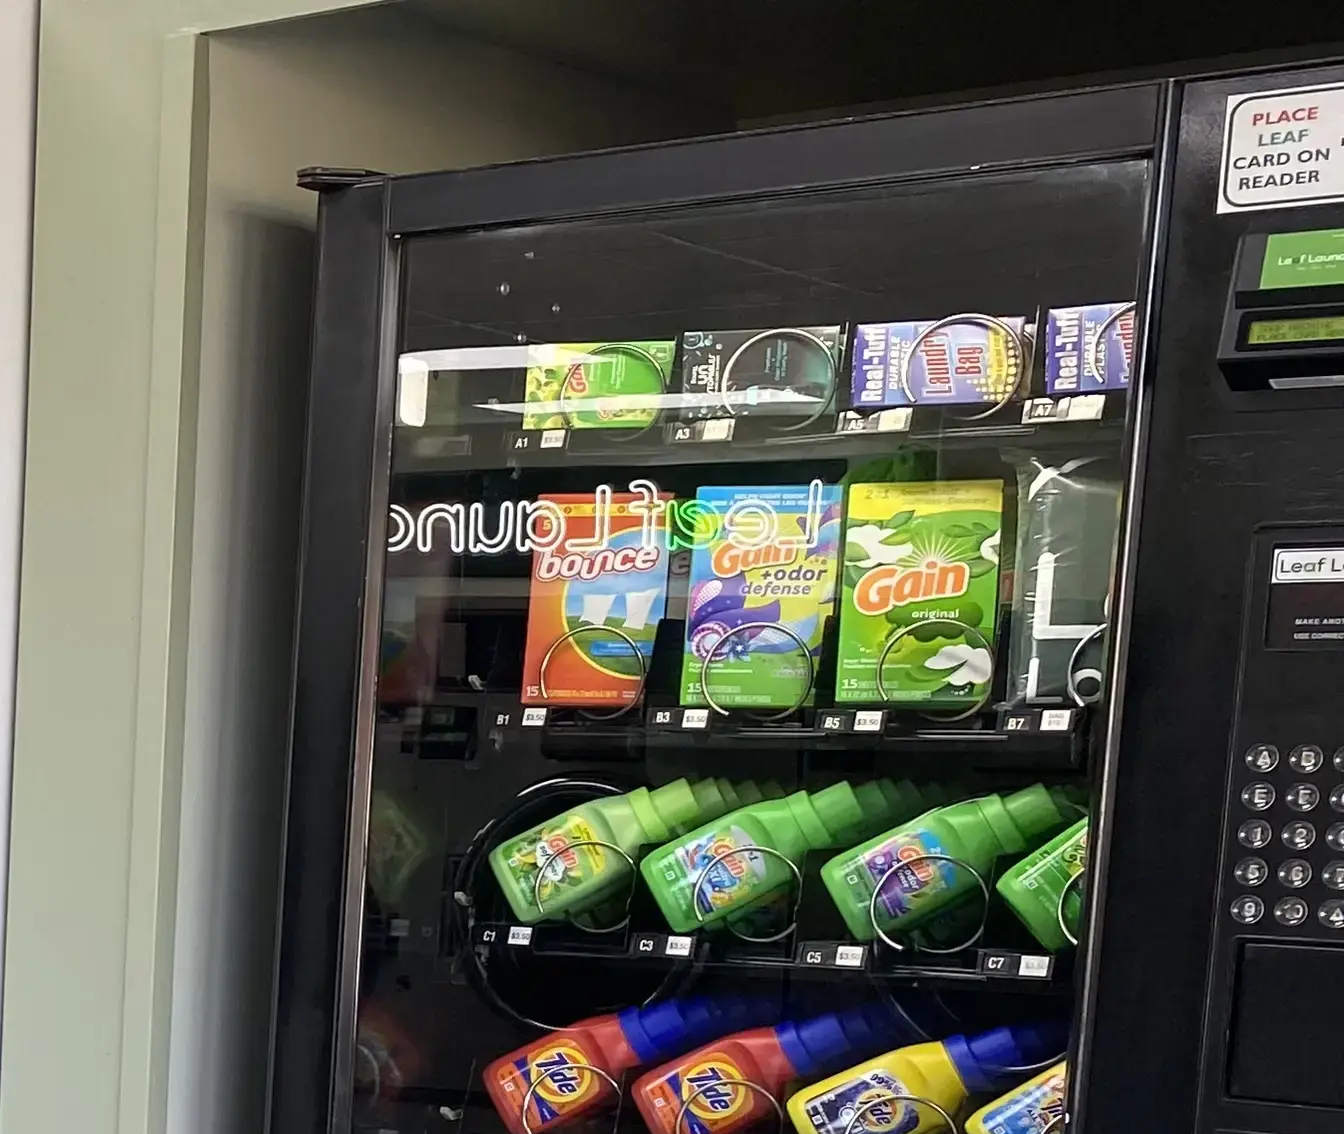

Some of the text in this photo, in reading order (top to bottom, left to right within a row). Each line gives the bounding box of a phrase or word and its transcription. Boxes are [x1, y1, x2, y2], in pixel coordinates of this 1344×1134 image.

[1252, 106, 1320, 126] PLACE
[1257, 128, 1310, 147] LEAF
[1233, 147, 1330, 170] CARD ON
[1238, 170, 1320, 191] READER
[861, 327, 887, 401] Real-Tuff
[888, 336, 901, 390] DURABLE
[954, 346, 984, 377] Bag
[1034, 403, 1053, 417] A7
[848, 419, 865, 431] A5
[675, 427, 691, 441] A3
[514, 437, 529, 449] A1
[536, 545, 661, 582] bounce
[713, 539, 797, 578] Gain
[1280, 557, 1344, 573] Leaf L
[760, 566, 828, 582] +odor
[741, 582, 812, 597] defense
[855, 560, 968, 613] Gain
[911, 607, 961, 621] original
[687, 682, 702, 693] 15
[841, 678, 858, 689] 15
[525, 685, 539, 698] 15
[496, 714, 510, 725] B1
[656, 711, 671, 723] B3
[823, 717, 841, 729] B5
[1007, 718, 1025, 730] B7
[482, 930, 497, 942] C1
[639, 939, 654, 952] C3
[806, 951, 822, 963] C5
[987, 956, 1005, 969] C7
